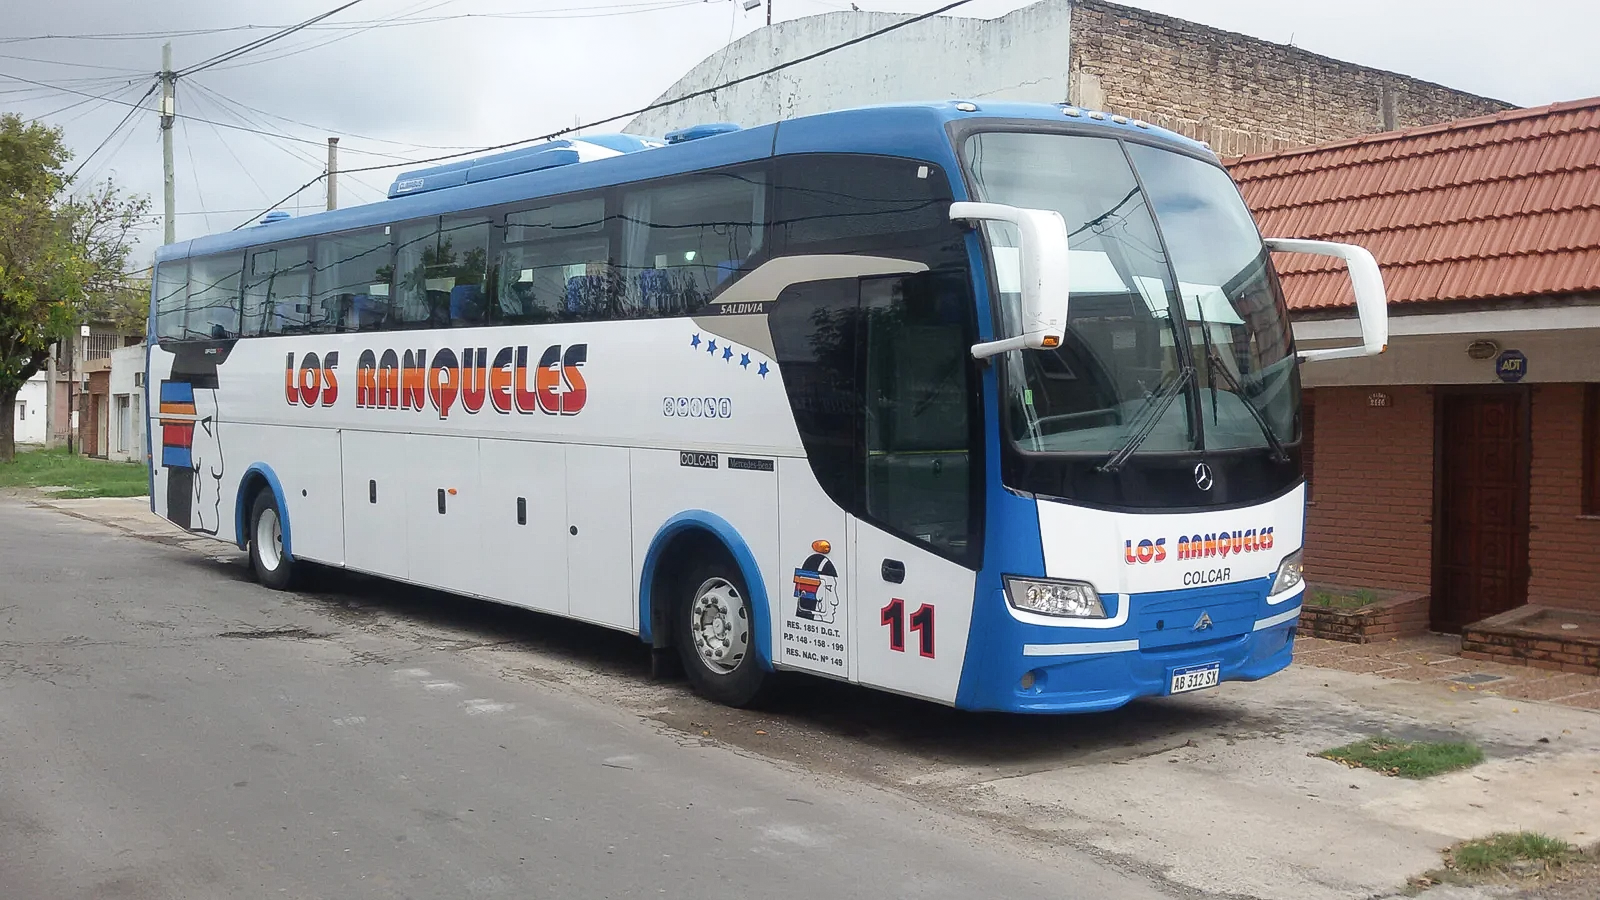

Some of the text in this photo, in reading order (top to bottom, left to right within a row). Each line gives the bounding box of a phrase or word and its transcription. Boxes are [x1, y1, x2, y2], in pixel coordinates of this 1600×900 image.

[720, 303, 763, 314] SALDIVIA
[1502, 359, 1523, 371] ADT
[285, 343, 588, 420] LOS RANQUELES
[680, 453, 718, 468] COLCAR
[729, 458, 773, 471] Mercedes-Benz
[1124, 526, 1274, 565] LOS RANQUELES
[1183, 567, 1231, 586] COLCAR
[786, 620, 841, 638] RES. 1851 D.G.T.
[881, 597, 935, 659] 11
[796, 635, 808, 645] 148
[814, 638, 826, 648] 158
[832, 642, 844, 652] 199
[786, 647, 802, 658] RES.
[803, 651, 819, 661] NAC.
[831, 657, 843, 667] 149
[1174, 670, 1218, 691] AB 312 SX
